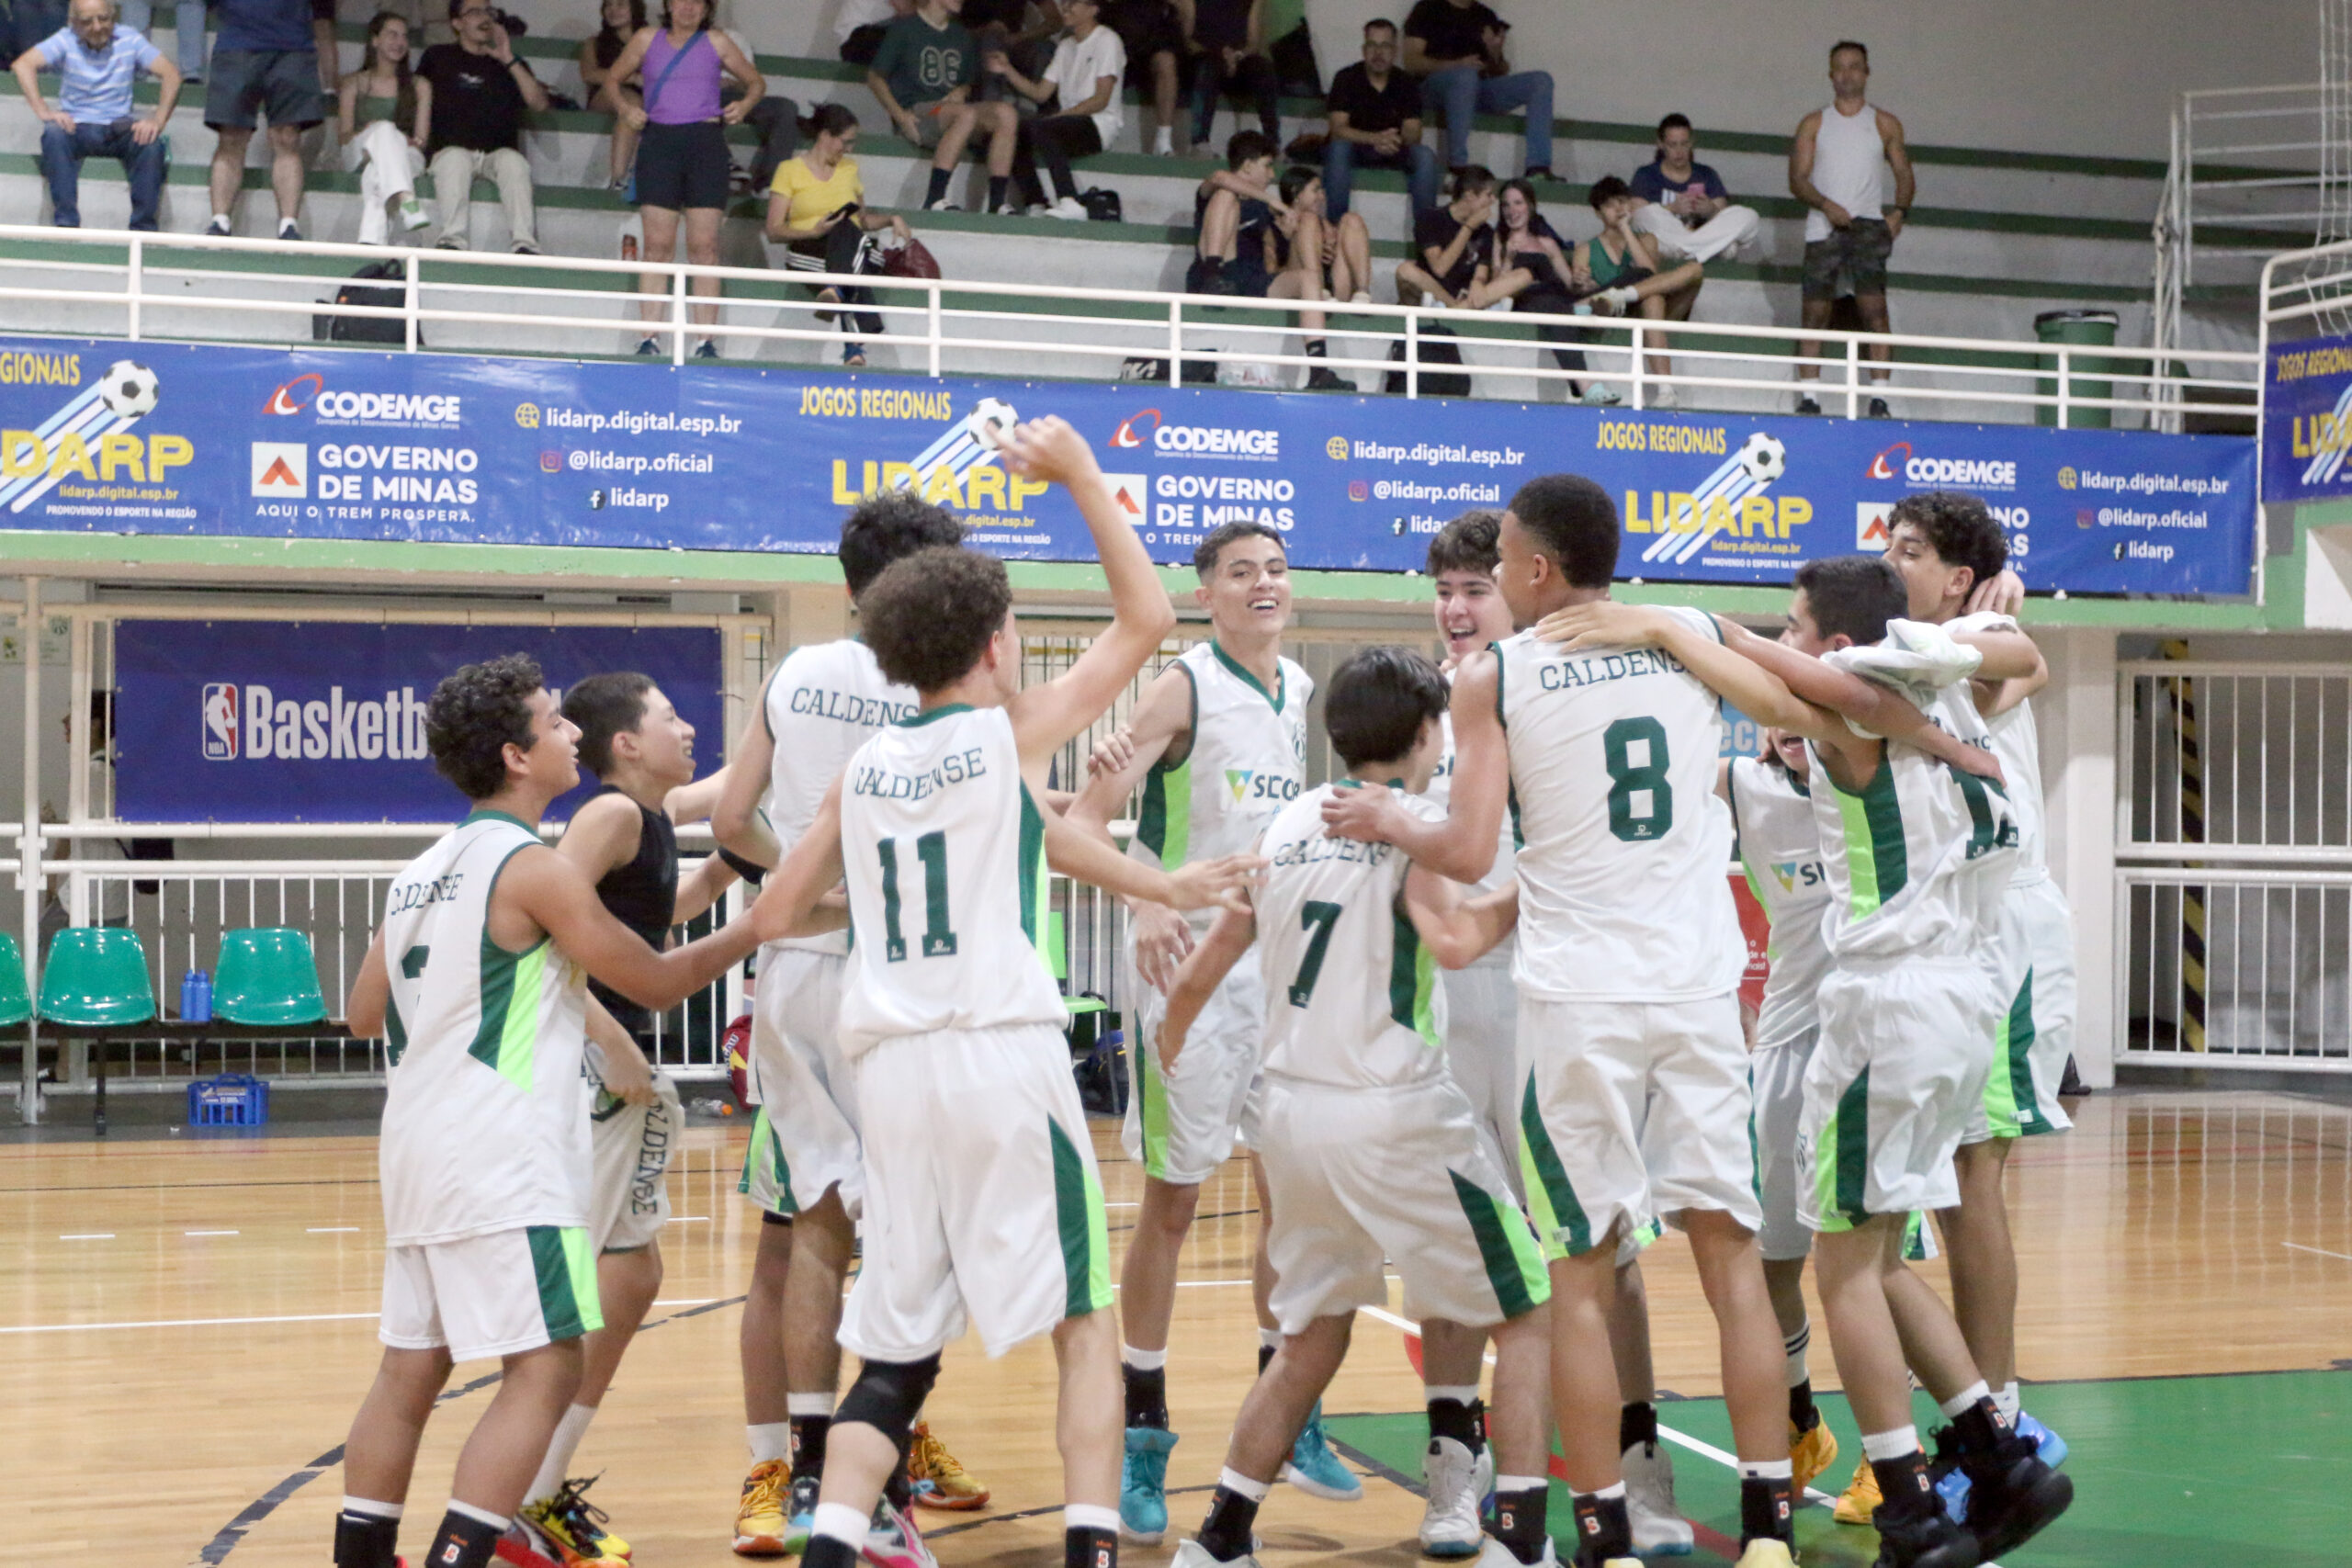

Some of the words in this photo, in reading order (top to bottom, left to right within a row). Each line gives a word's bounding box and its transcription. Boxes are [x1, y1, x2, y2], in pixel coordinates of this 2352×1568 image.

[316, 390, 460, 422] CODEMGE
[799, 387, 856, 417] JOGOS
[861, 389, 952, 421] REGIONAIS
[547, 408, 741, 436] lidarp.digital.esp.br
[1154, 425, 1279, 454] CODEMGE
[1596, 422, 1645, 450] JOGOS
[1649, 425, 1726, 455] REGIONAIS
[2, 430, 194, 482] DARP
[318, 444, 478, 472] GOVERNO
[569, 451, 713, 475] @lidarp.oficial
[1354, 441, 1525, 468] lidarp.digital.esp.br
[832, 458, 1048, 511] LIDARP
[1905, 457, 2017, 485] CODEMGE
[2081, 470, 2229, 497] lidarp.digital.esp.br
[59, 484, 179, 502] lidarp.digital.esp.br
[319, 474, 362, 500] DE
[373, 476, 478, 504] MINAS
[610, 488, 670, 513] lidarp
[1156, 475, 1295, 502] GOVERNO
[1374, 480, 1499, 504] @lidarp.oficial
[47, 505, 104, 516] PROMOVENDO
[114, 506, 150, 517] ESPORTE
[152, 507, 164, 518] NA
[256, 504, 299, 517] AQUI
[307, 505, 318, 518] O
[328, 506, 372, 520] TREM
[380, 508, 476, 523] PROSPERA.
[1156, 503, 1193, 527] DE
[1625, 490, 1814, 539] LIDARP
[2098, 508, 2208, 531] @lidarp.oficial
[1146, 533, 1157, 544] O
[1164, 534, 1203, 545] TREM
[1712, 539, 1802, 554] lidarp.digital.esp.br
[2128, 540, 2175, 563] lidarp
[208, 741, 226, 755] NBA
[1603, 716, 1673, 842] 8
[876, 830, 958, 964] 11
[1287, 900, 1343, 1010] 7
